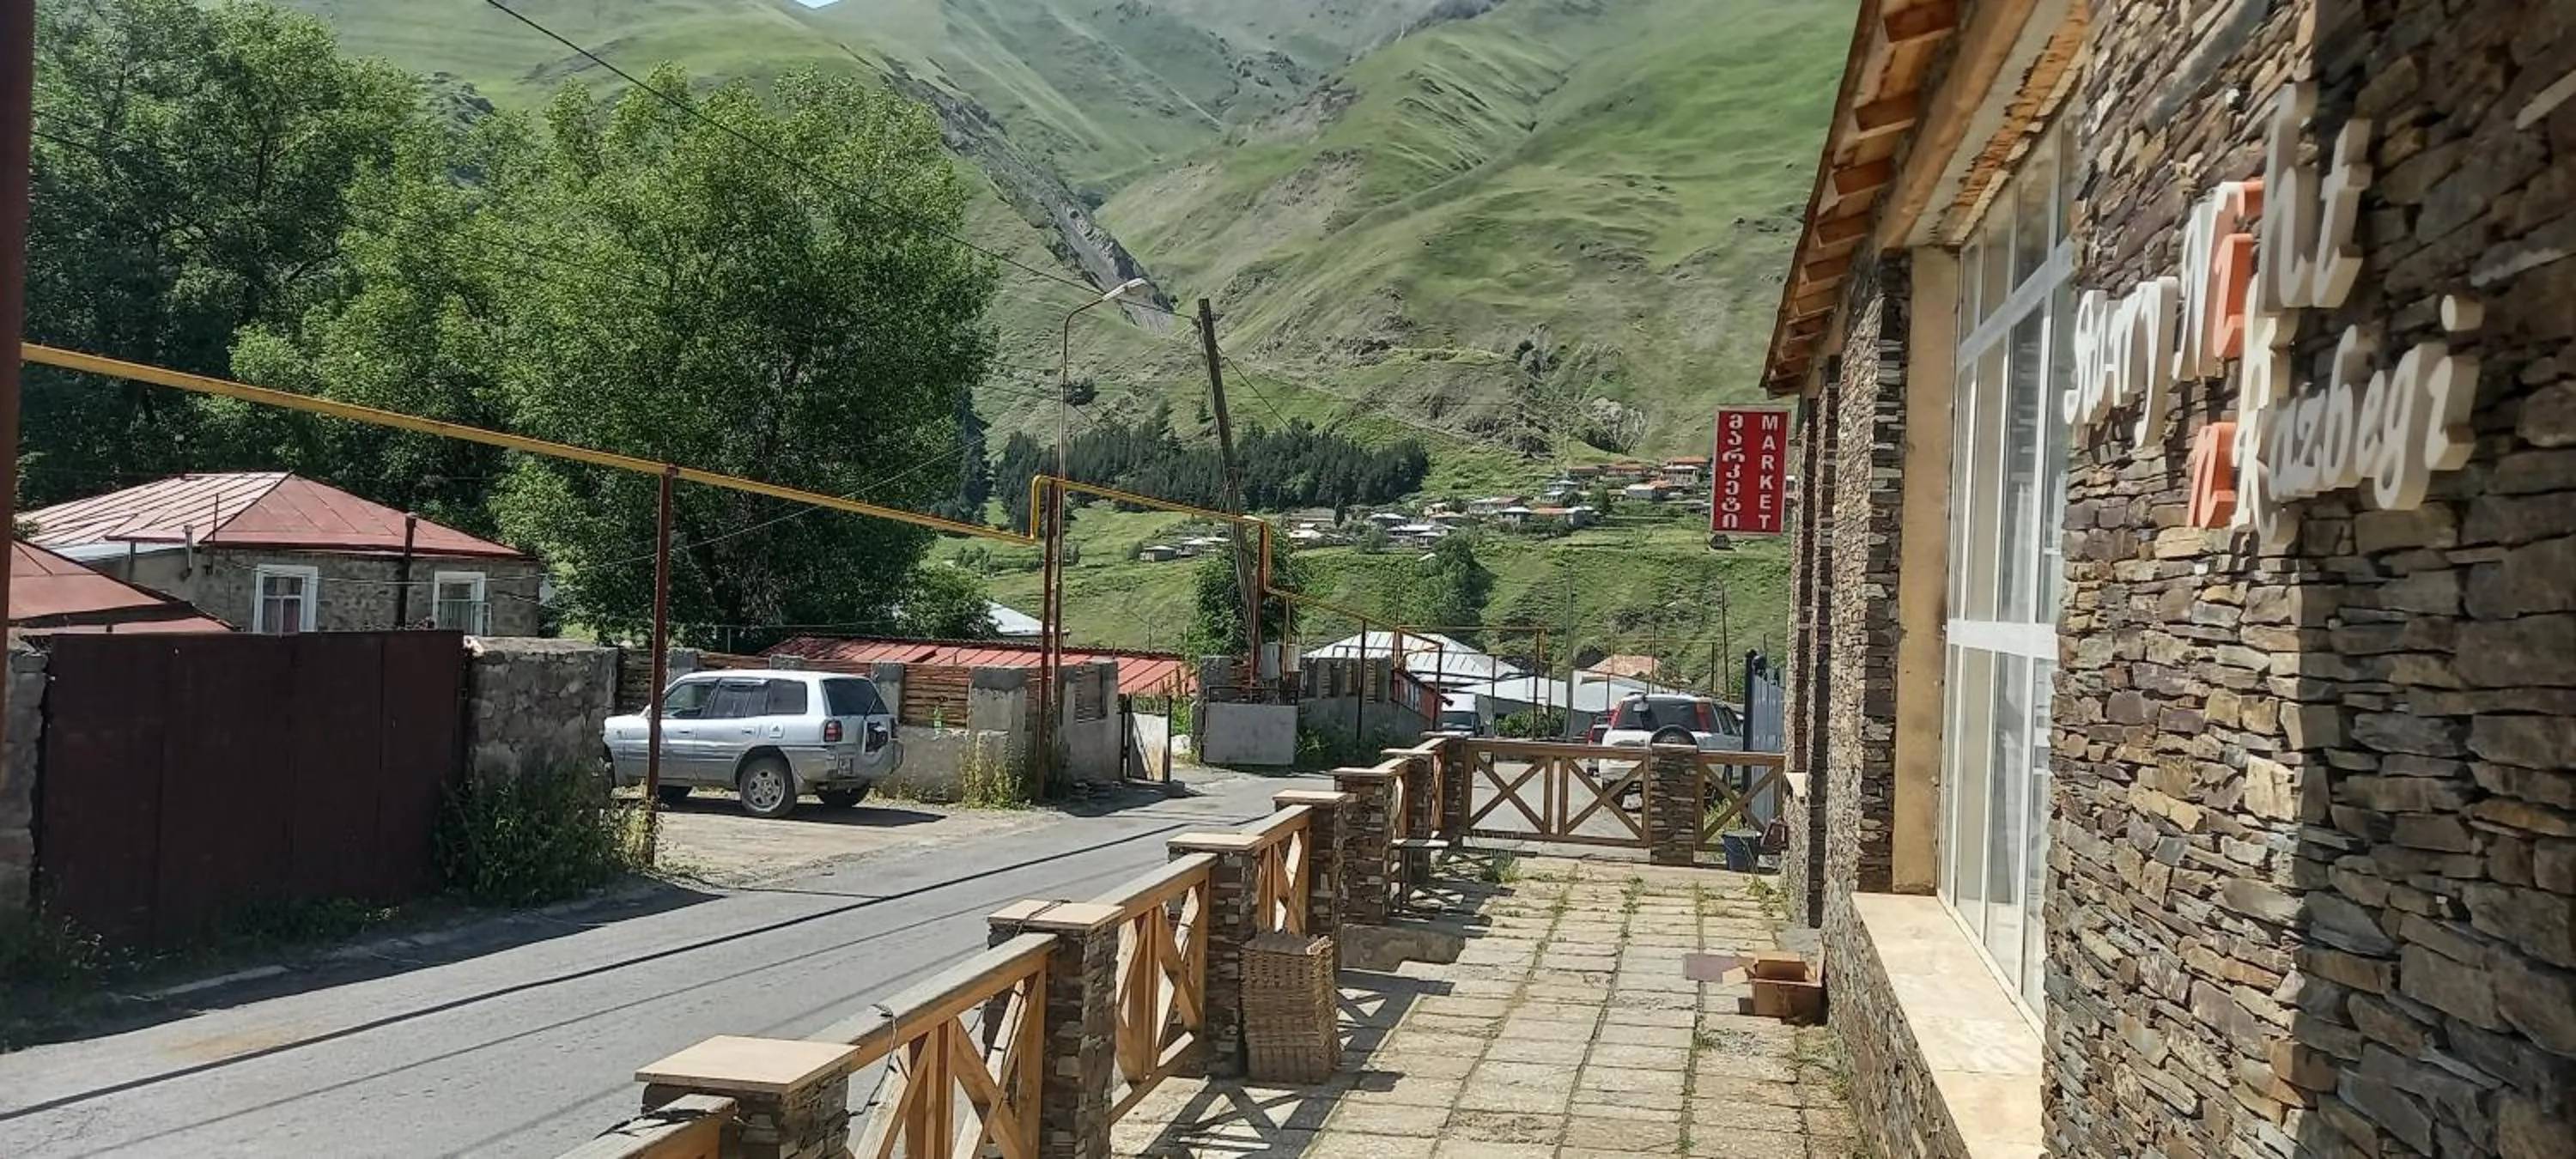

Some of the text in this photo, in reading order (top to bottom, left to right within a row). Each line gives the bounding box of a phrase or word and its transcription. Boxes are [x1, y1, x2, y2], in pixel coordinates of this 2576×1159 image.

[2064, 278, 2172, 446] Starry
[2231, 295, 2476, 549] Kazbegi
[1721, 413, 1746, 528] მარკეტი
[1758, 415, 1778, 530] MARKET
